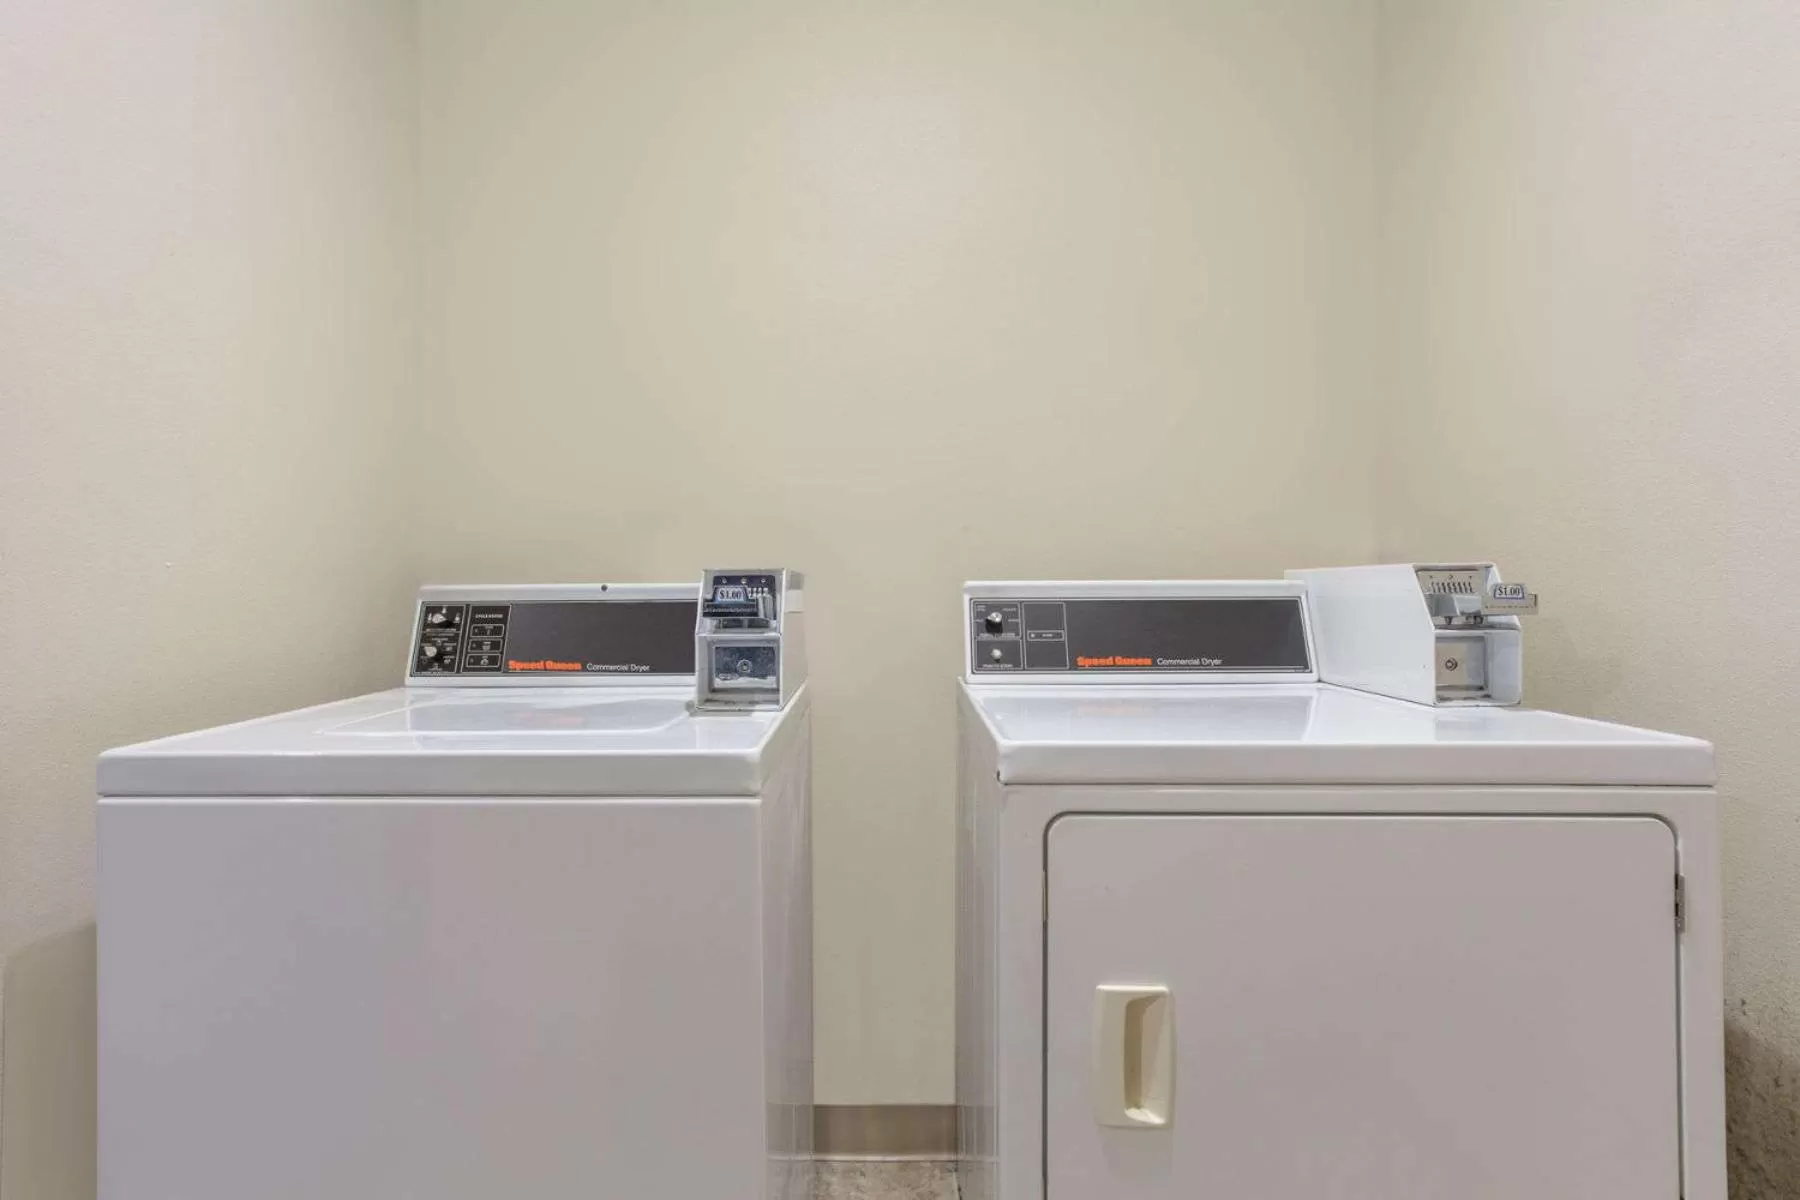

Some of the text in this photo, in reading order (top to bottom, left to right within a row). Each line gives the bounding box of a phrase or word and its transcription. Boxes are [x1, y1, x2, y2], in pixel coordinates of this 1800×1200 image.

[1498, 586, 1520, 596] $1.00
[508, 660, 650, 672] Speed Queen Commercial Dryer
[1076, 656, 1222, 669] Speed Queen Commercial Dryer
